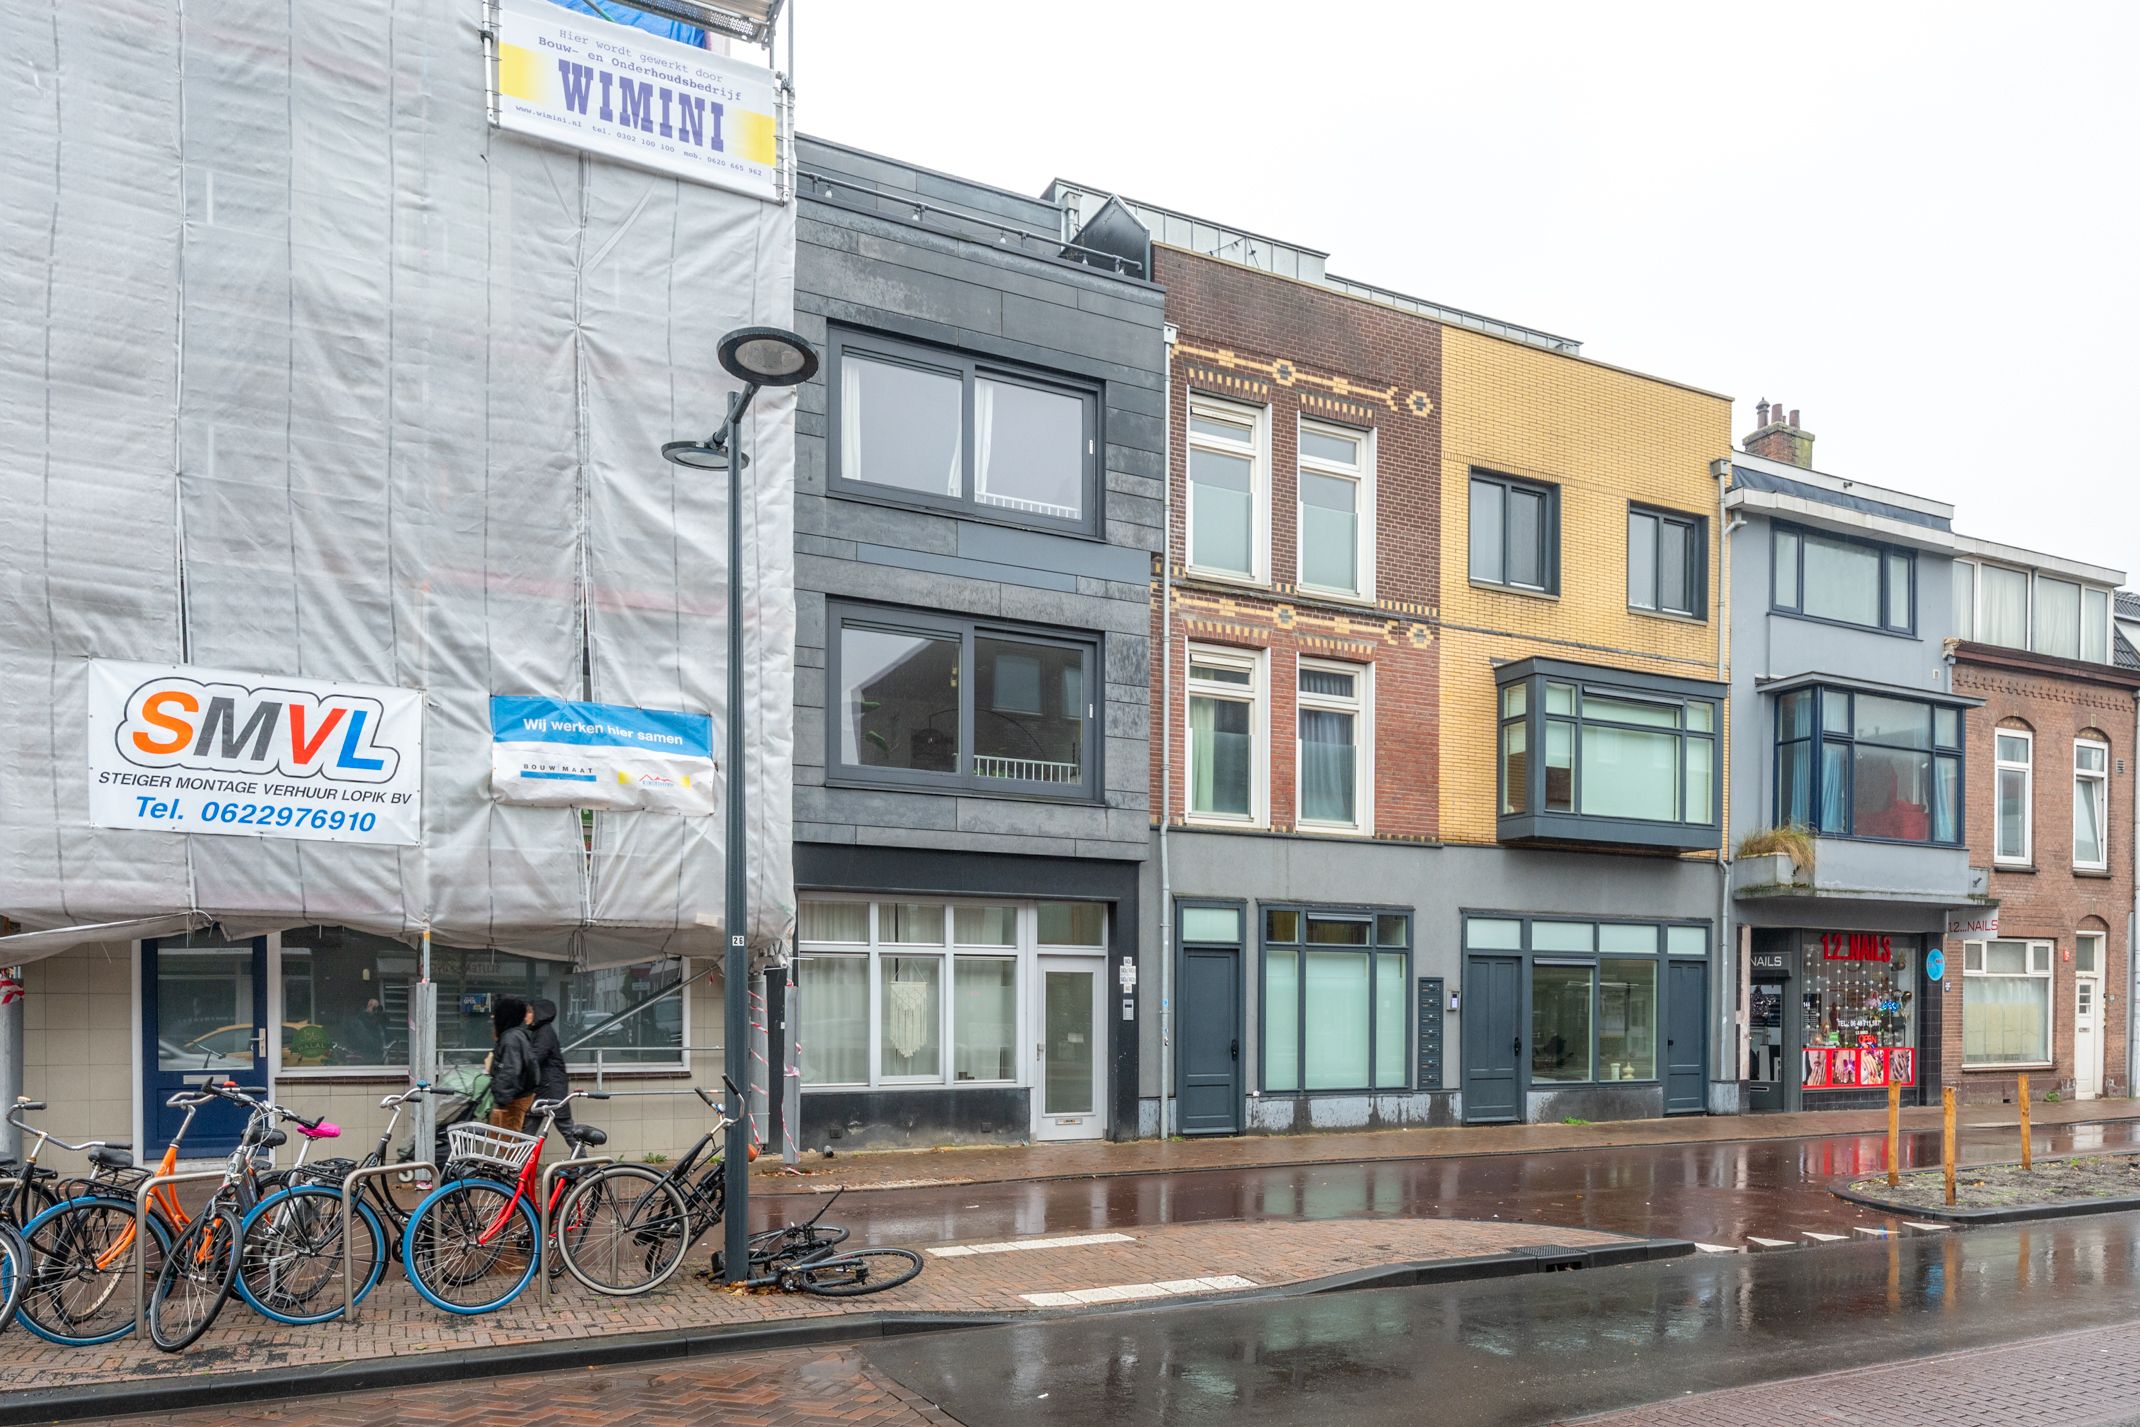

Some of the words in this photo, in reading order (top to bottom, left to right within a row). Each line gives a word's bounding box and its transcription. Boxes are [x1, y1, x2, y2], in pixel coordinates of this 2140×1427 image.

[538, 36, 580, 54] Bouw-
[587, 51, 604, 63] en
[611, 57, 742, 101] Onderhoudsbedrijf
[559, 29, 589, 45] Hier
[596, 40, 632, 58] wordt
[639, 52, 689, 74] gewerkt
[695, 66, 723, 84] door
[558, 59, 724, 152] WIMINI
[515, 105, 582, 128] www.wimini.nl
[592, 125, 612, 137] tel.
[616, 131, 637, 144] 0302
[641, 137, 656, 148] 100
[660, 143, 675, 153] 100
[683, 150, 703, 162] mob.
[707, 156, 726, 168] 0620
[132, 691, 385, 771] SMVL
[523, 718, 547, 732] Wij
[551, 720, 604, 734] werken
[607, 725, 634, 738] hier
[637, 731, 683, 745] samen
[98, 771, 172, 788] STEIGER
[175, 777, 258, 794] MONTAGE
[264, 783, 338, 800] VERHUUR
[341, 789, 387, 804] LOPIK
[390, 792, 412, 805] BV
[136, 796, 184, 820] Tel.
[201, 801, 377, 832] 0622976910
[733, 936, 744, 945] 26
[1750, 956, 1782, 967] NAILS
